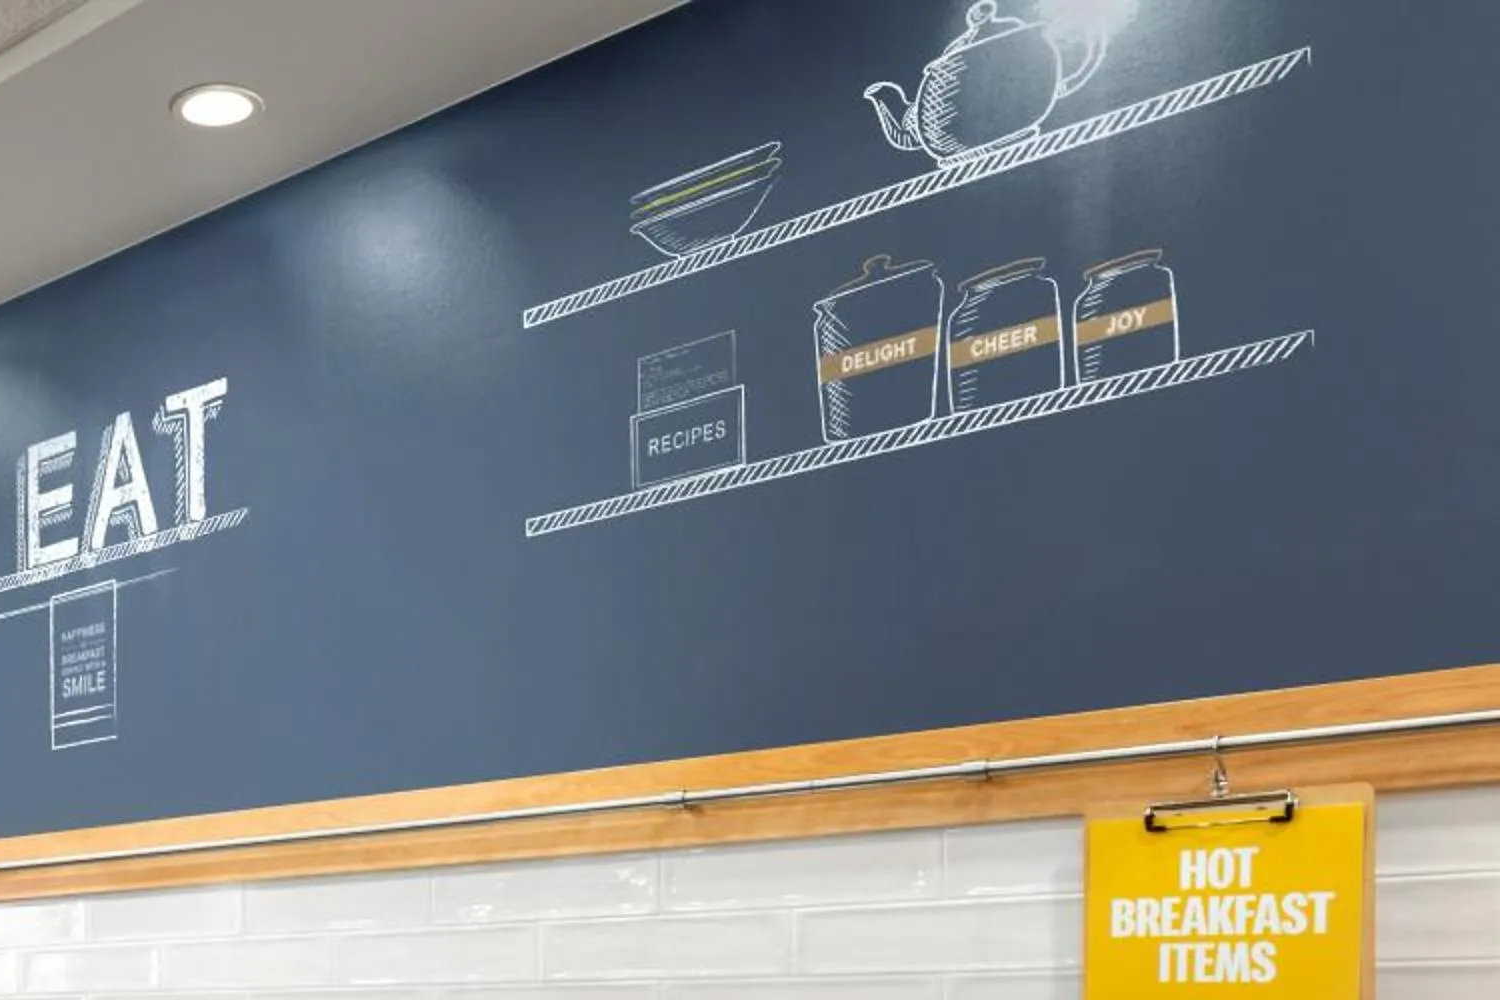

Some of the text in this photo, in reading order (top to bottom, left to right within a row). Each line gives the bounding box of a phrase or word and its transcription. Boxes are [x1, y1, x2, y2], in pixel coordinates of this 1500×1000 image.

[1107, 307, 1147, 335] JOY
[841, 337, 916, 373] DELIGHT
[970, 325, 1038, 358] CHEER
[647, 419, 726, 457] RECIPES
[16, 377, 228, 573] EAT
[62, 671, 106, 698] SMILE
[1179, 846, 1259, 890] HOT
[1110, 891, 1335, 937] BREAKFAST
[1158, 941, 1277, 983] ITEMS
